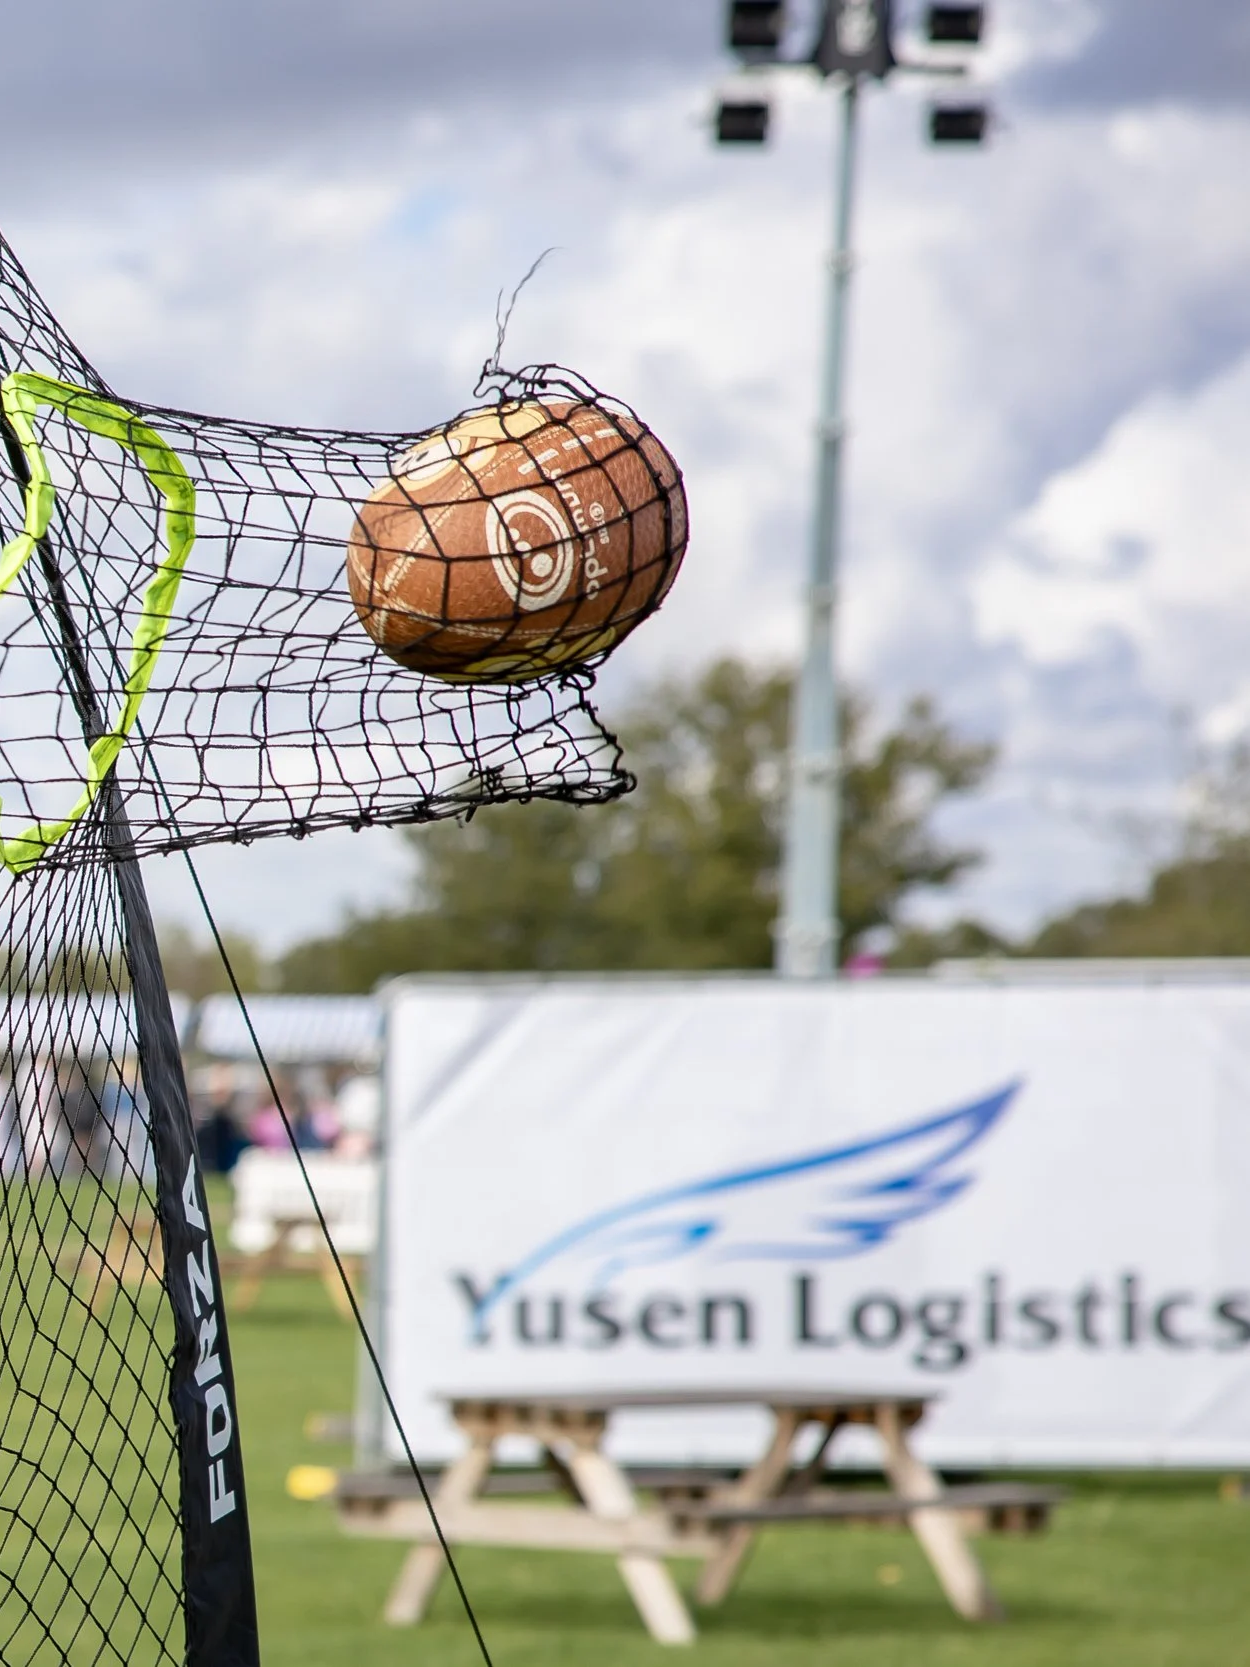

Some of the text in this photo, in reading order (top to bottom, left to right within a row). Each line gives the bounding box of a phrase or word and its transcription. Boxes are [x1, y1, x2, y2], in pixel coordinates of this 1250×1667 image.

[181, 1153, 236, 1525] FORZA
[453, 1270, 1250, 1370] Yusen Logistics
